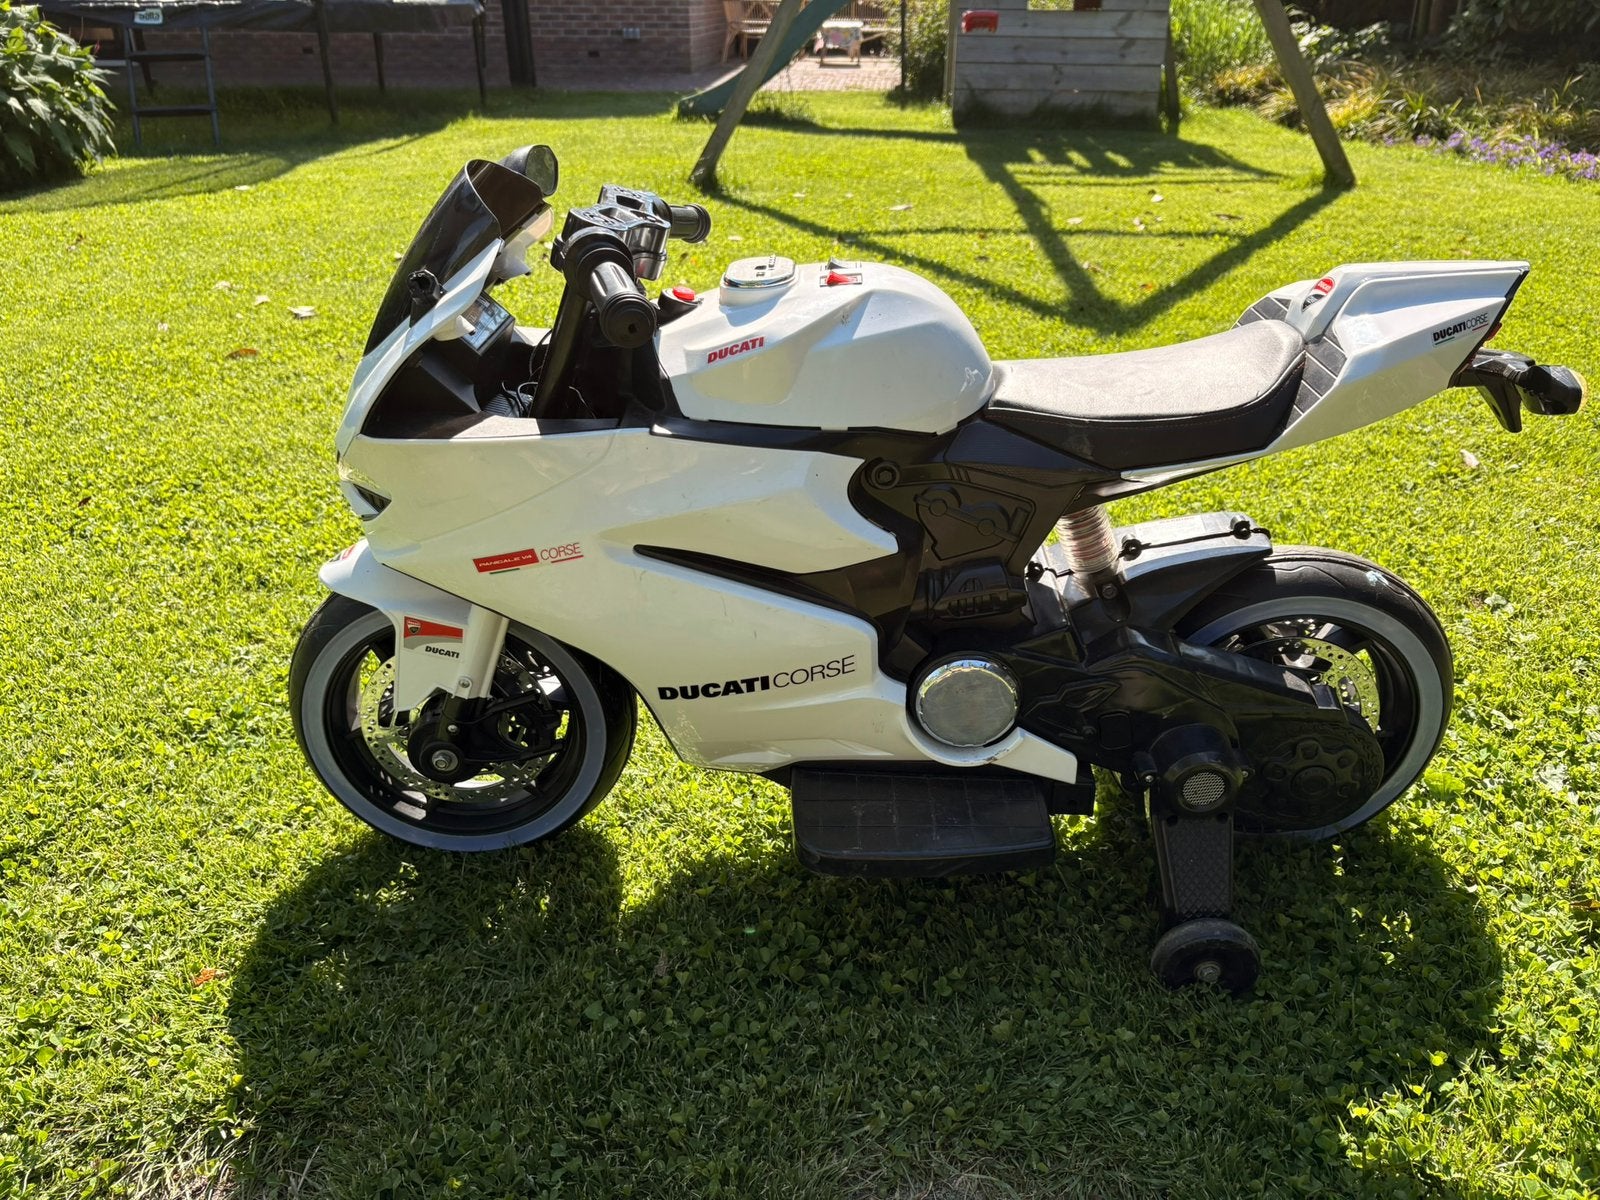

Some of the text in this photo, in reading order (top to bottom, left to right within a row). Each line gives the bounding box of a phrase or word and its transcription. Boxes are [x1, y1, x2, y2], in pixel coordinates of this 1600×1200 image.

[707, 336, 765, 364] DUCATI
[540, 542, 582, 561] CORSE
[425, 645, 461, 659] DUCATI
[657, 675, 770, 700] DUCATI
